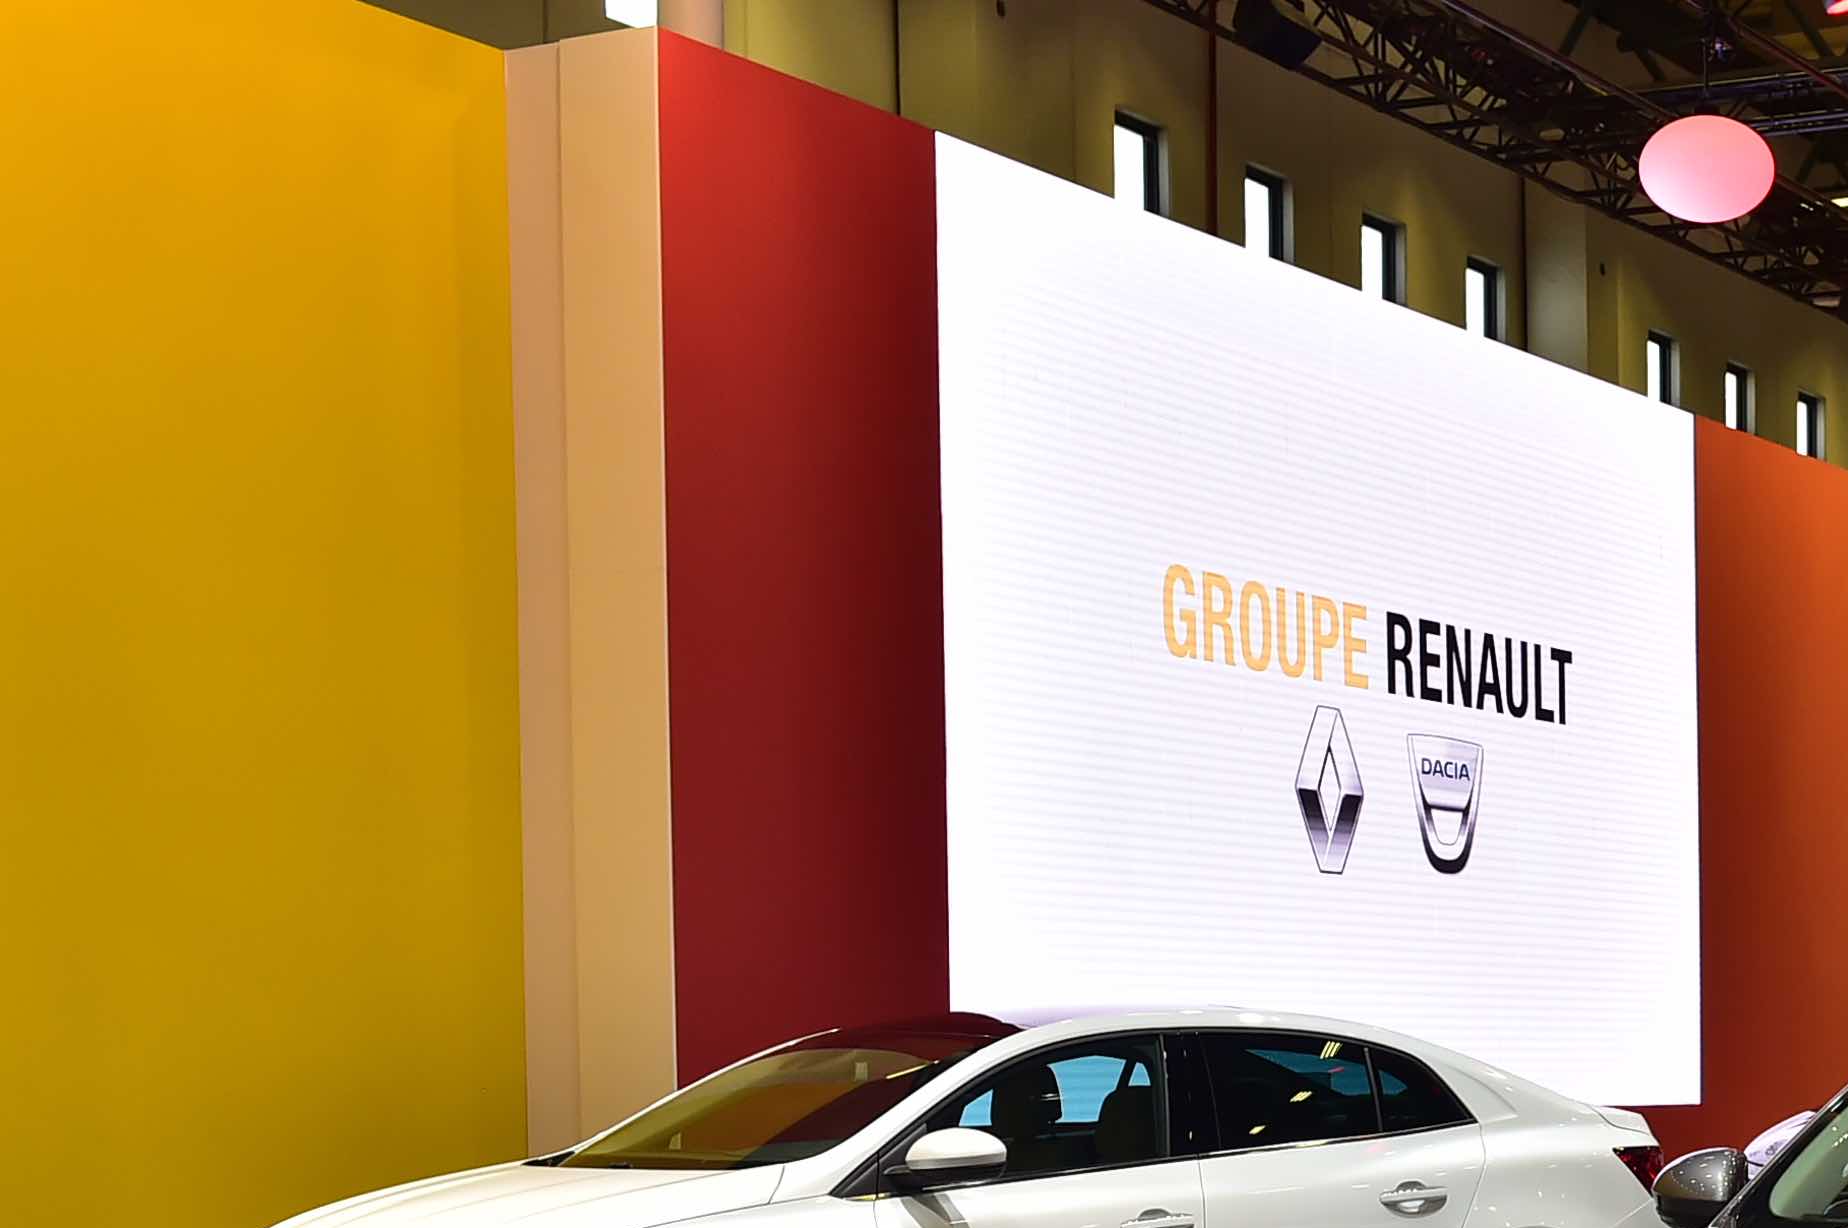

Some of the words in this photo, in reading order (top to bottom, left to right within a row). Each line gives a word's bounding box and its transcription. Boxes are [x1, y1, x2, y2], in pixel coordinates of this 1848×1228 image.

[1162, 563, 1369, 690] GROUPE
[1386, 611, 1573, 726] RENAULT
[1420, 757, 1471, 782] DACIA
